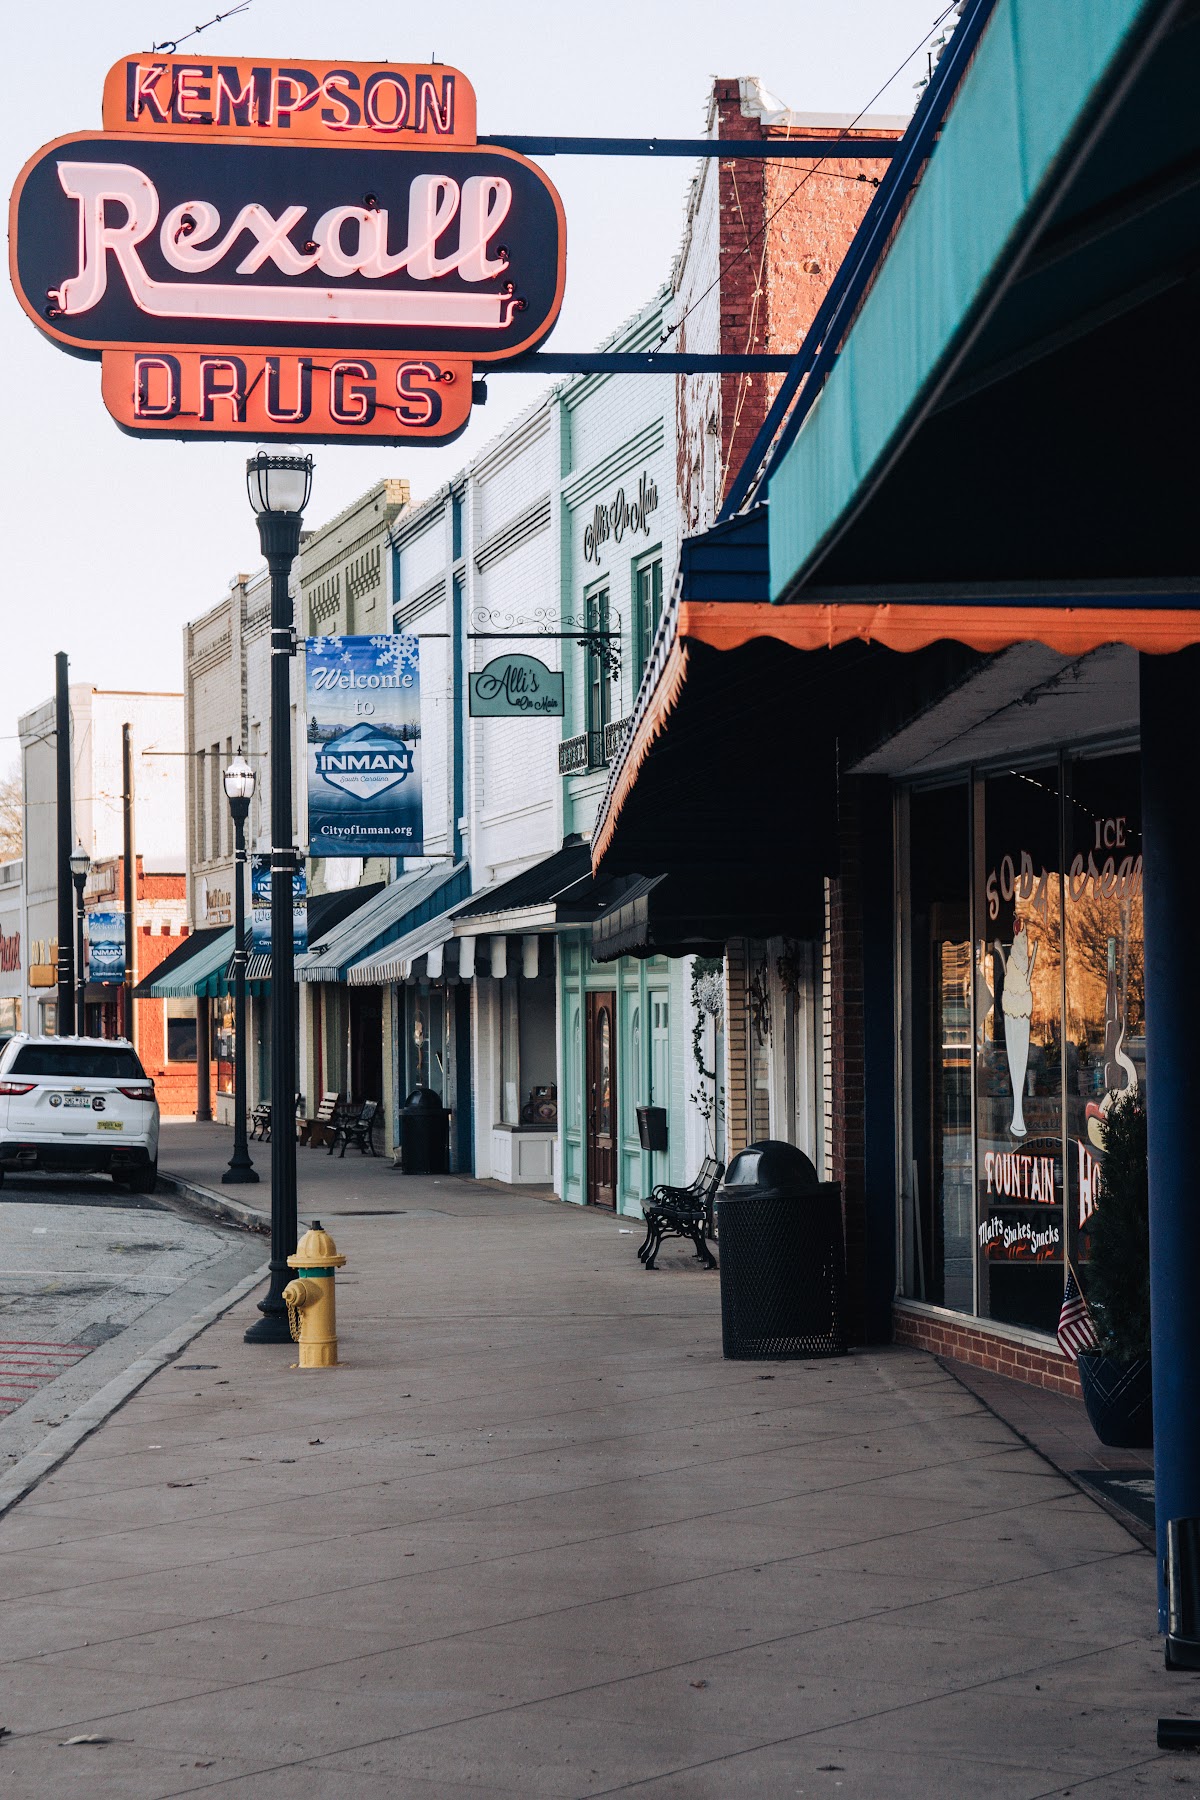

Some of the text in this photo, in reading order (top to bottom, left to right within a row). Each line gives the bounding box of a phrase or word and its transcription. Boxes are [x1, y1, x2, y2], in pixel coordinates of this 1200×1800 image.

[126, 61, 457, 135] KEMPSON
[56, 160, 515, 328] Rexall
[133, 353, 443, 427] DRUGS
[311, 666, 414, 690] Welcome
[475, 664, 540, 706] Alli's
[353, 698, 376, 716] to
[320, 754, 409, 771] INMAN
[320, 824, 413, 837] CityofInman.org
[1095, 816, 1127, 849] ICE
[257, 882, 301, 891] INN
[986, 850, 1049, 926] SODA
[984, 1151, 1055, 1204] FOUNTAIN
[978, 1215, 1004, 1248] Malts
[1003, 1222, 1031, 1248] Shakes
[1031, 1224, 1060, 1254] Snacks
